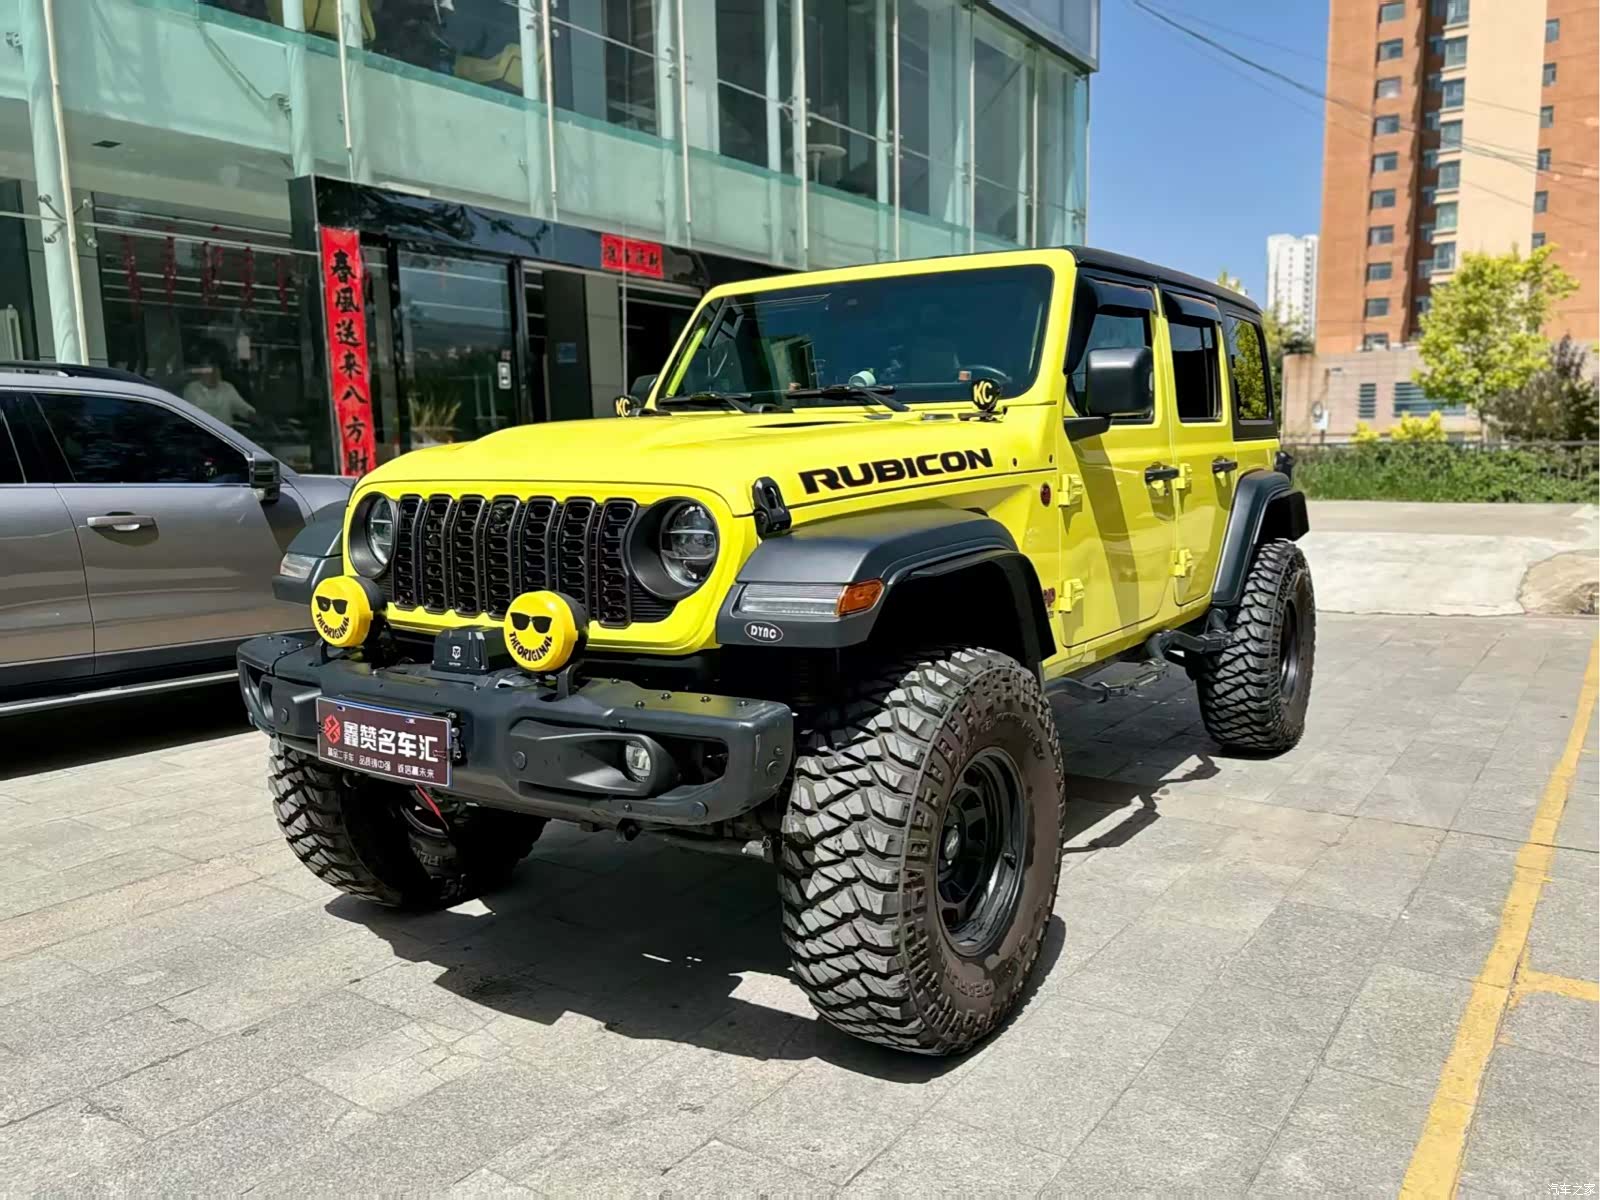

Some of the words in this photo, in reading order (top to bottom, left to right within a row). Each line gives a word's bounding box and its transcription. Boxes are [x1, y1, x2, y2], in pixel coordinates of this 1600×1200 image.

[973, 380, 993, 404] KC
[615, 397, 631, 417] KC
[798, 448, 993, 495] RUBICON
